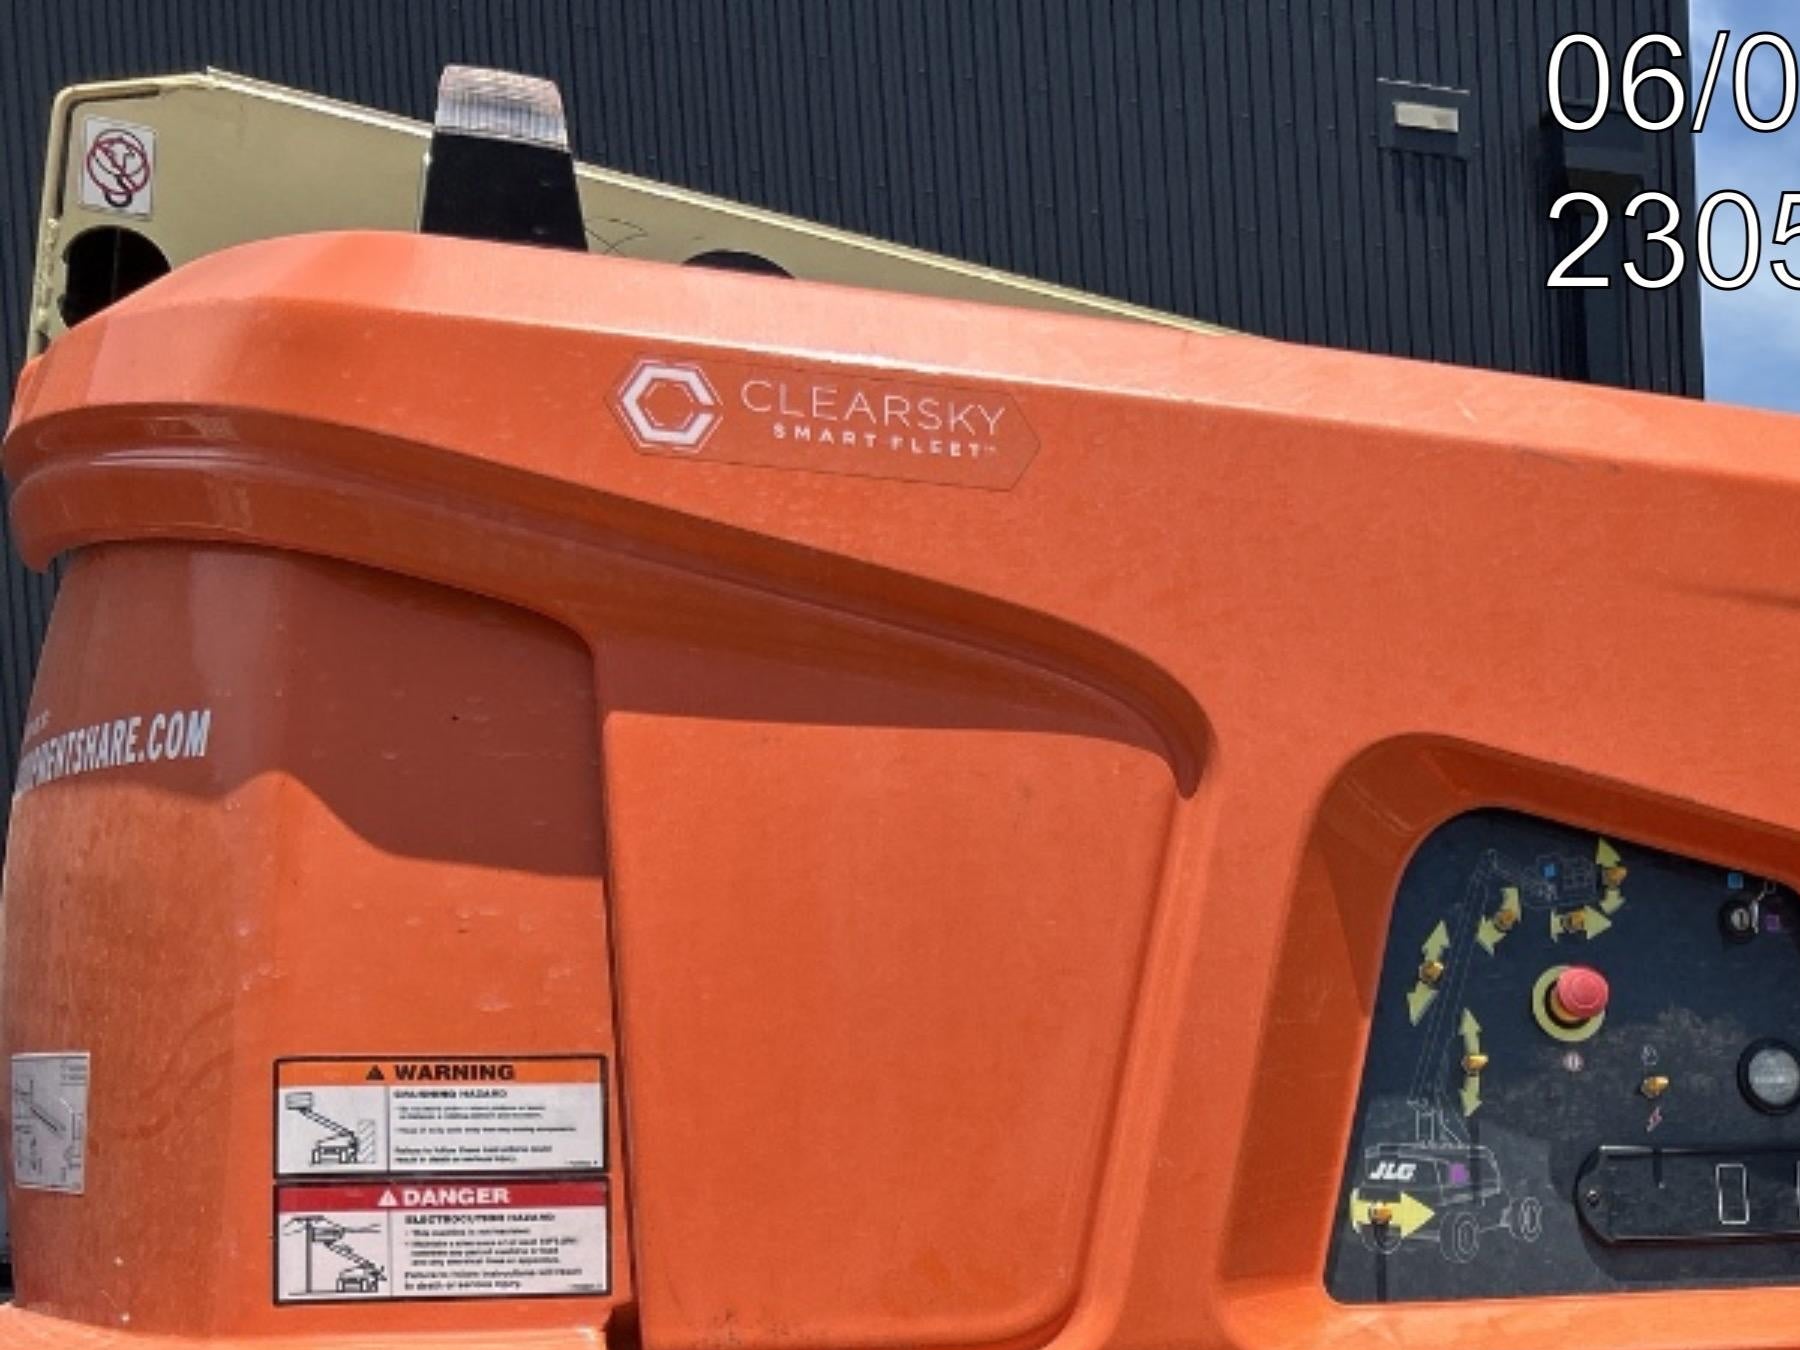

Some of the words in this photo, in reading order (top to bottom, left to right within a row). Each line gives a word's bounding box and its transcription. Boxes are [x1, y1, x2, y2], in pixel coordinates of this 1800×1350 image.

[741, 379, 1006, 436] CLEARSKY
[773, 421, 876, 449] SMART
[394, 1064, 515, 1081] WARNING
[1368, 1160, 1417, 1180] JLG
[403, 1188, 510, 1206] DANGER
